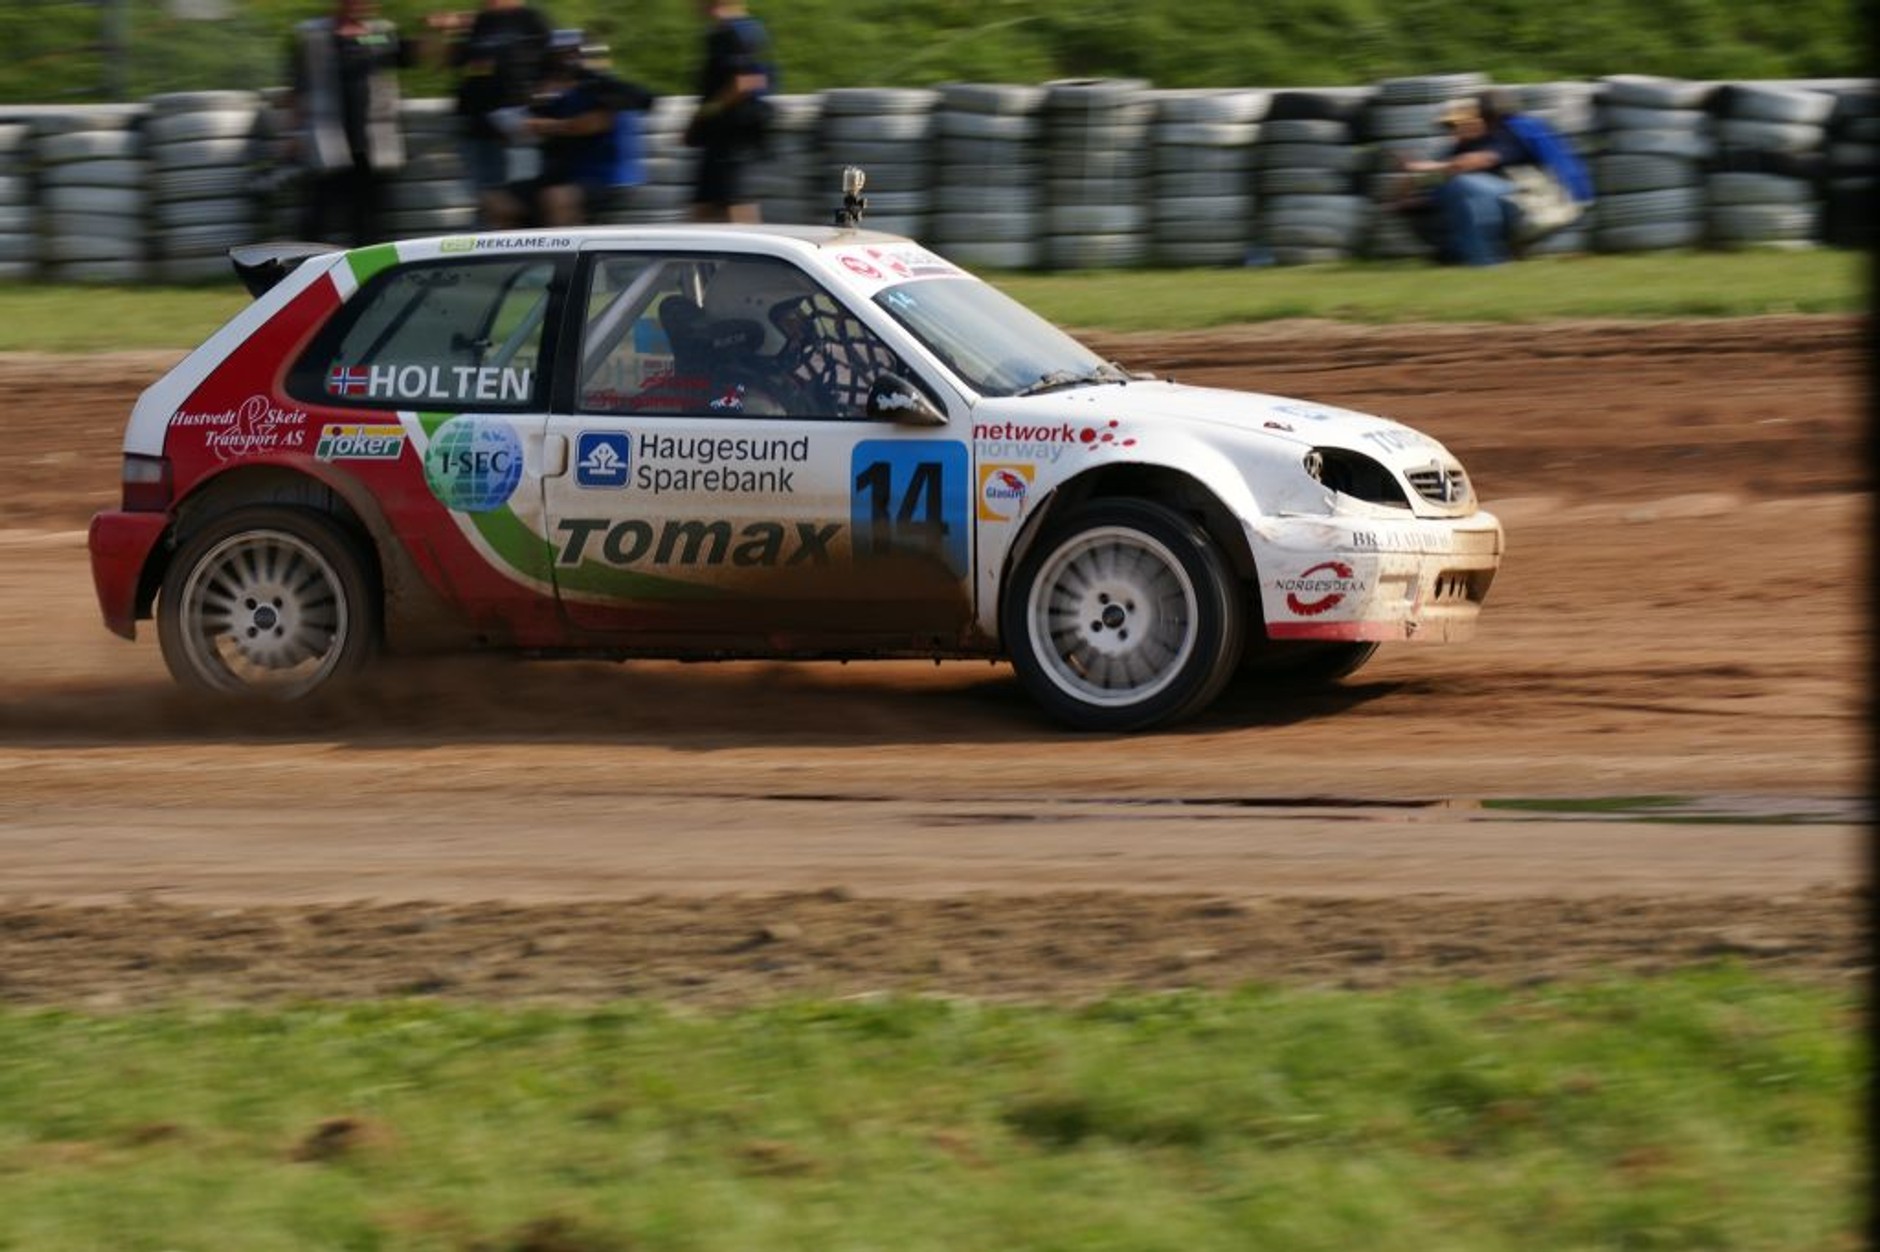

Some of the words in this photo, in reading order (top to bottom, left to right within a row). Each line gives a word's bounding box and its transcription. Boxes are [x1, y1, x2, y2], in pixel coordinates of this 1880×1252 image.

[368, 365, 531, 400] HOLTEN
[171, 411, 236, 427] Hustvedt
[264, 408, 307, 424] Skeie
[205, 430, 279, 448] Transport
[281, 430, 306, 446] AS
[325, 424, 394, 463] joker
[973, 421, 1075, 443] network
[639, 434, 809, 464] Haugesund
[976, 441, 1065, 464] norway
[442, 451, 509, 474] I-SEC
[637, 465, 794, 495] Sparebank
[855, 461, 950, 556] 14
